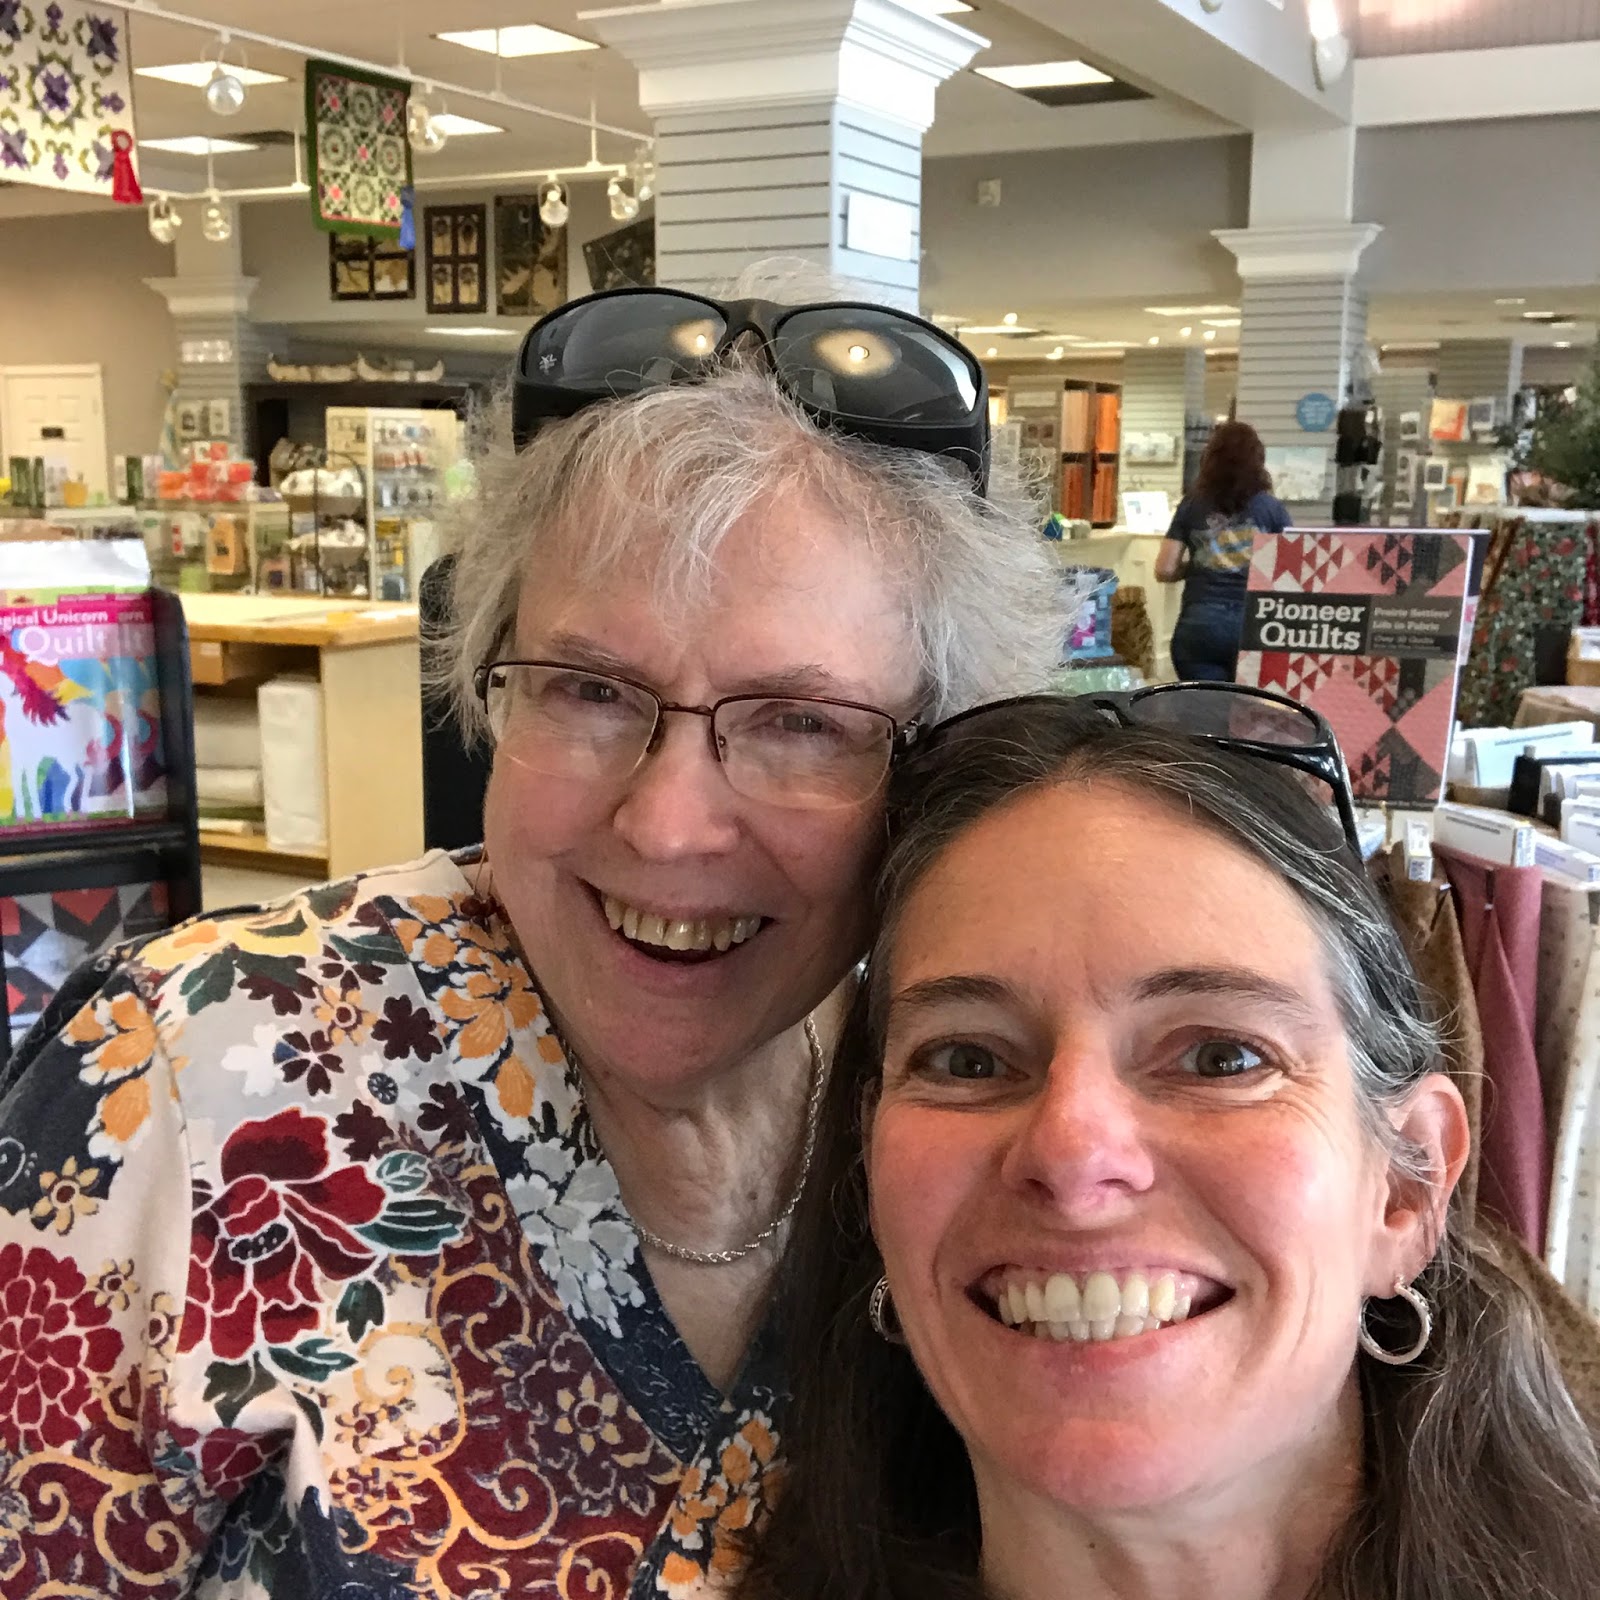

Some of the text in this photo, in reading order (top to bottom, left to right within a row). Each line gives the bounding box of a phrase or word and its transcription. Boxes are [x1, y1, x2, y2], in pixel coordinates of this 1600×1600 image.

[42, 608, 108, 625] Unicorn
[1255, 598, 1365, 622] Pioneer
[18, 623, 106, 667] Quilt
[1260, 622, 1361, 650] Quilts
